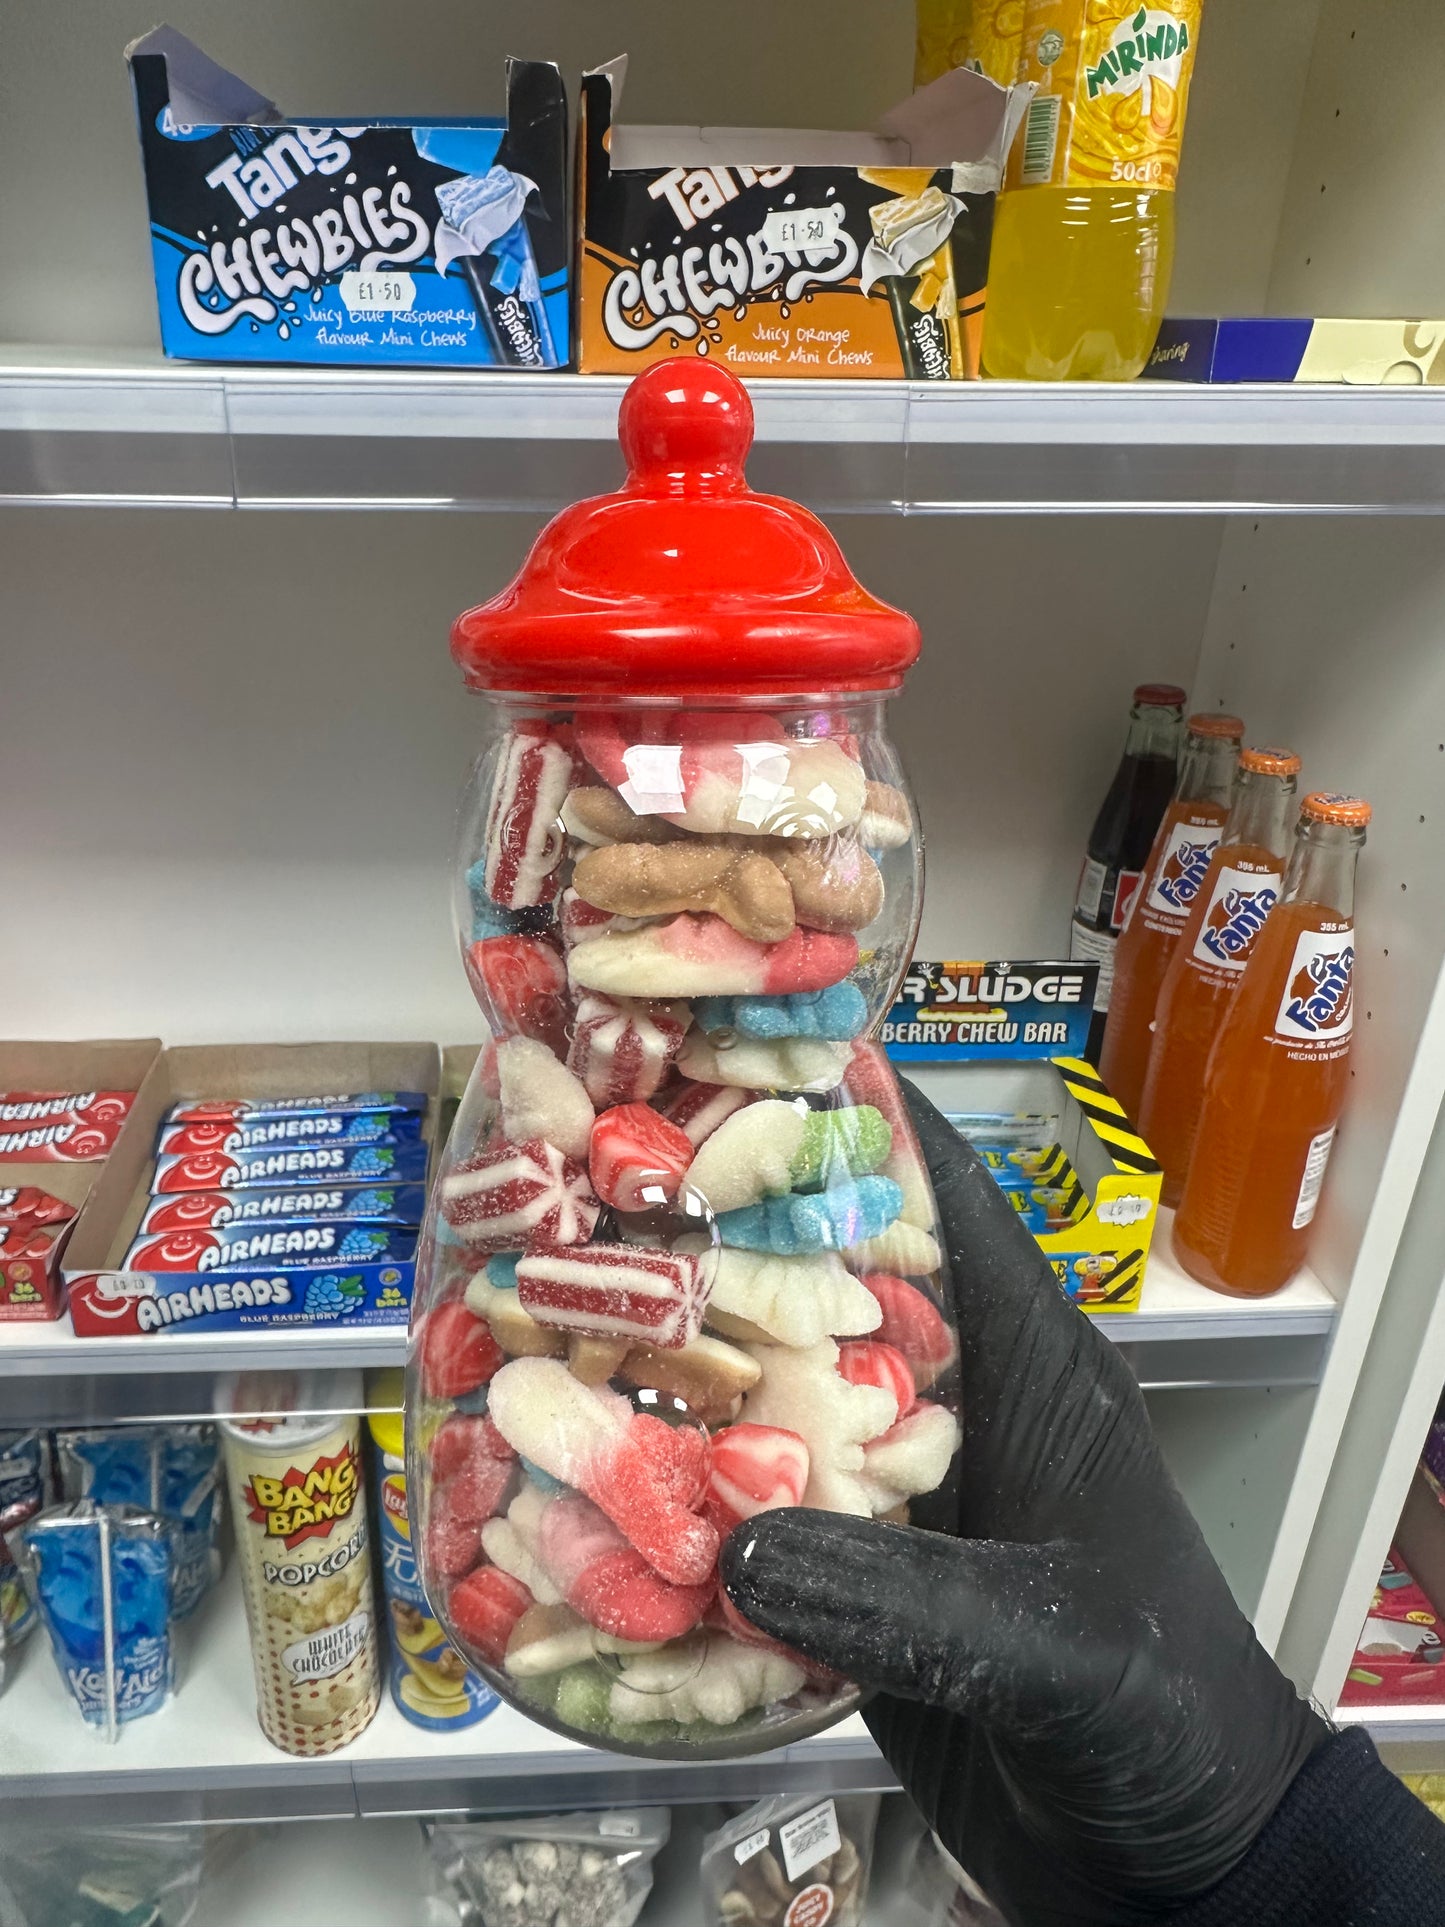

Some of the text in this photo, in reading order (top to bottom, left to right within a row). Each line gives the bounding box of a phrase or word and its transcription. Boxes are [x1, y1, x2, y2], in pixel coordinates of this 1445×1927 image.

[180, 182, 430, 335] CHEWBIES
[304, 304, 342, 330] Juicy
[752, 322, 790, 348] Juicy
[380, 327, 414, 346] Mini
[420, 330, 468, 347] Chews
[786, 345, 821, 364] Mini
[827, 347, 874, 365] Chews
[1202, 887, 1278, 961] Fanta
[1320, 921, 1337, 932] 355
[935, 975, 1084, 1003] SLUDGE
[1285, 945, 1355, 1032] Fanta
[957, 1021, 1018, 1044] CHEW
[1023, 1021, 1067, 1044] BAR
[223, 1116, 343, 1154] AIRHEADS
[220, 1148, 345, 1188] AIRHEADS
[210, 1190, 344, 1228] AIRHEADS
[198, 1226, 336, 1274] AIRHEADS
[136, 1276, 293, 1333] AIRHEADS
[248, 1457, 356, 1512] BANG
[265, 1489, 353, 1536] BANG
[68, 1656, 165, 1702] Kol-Aid
